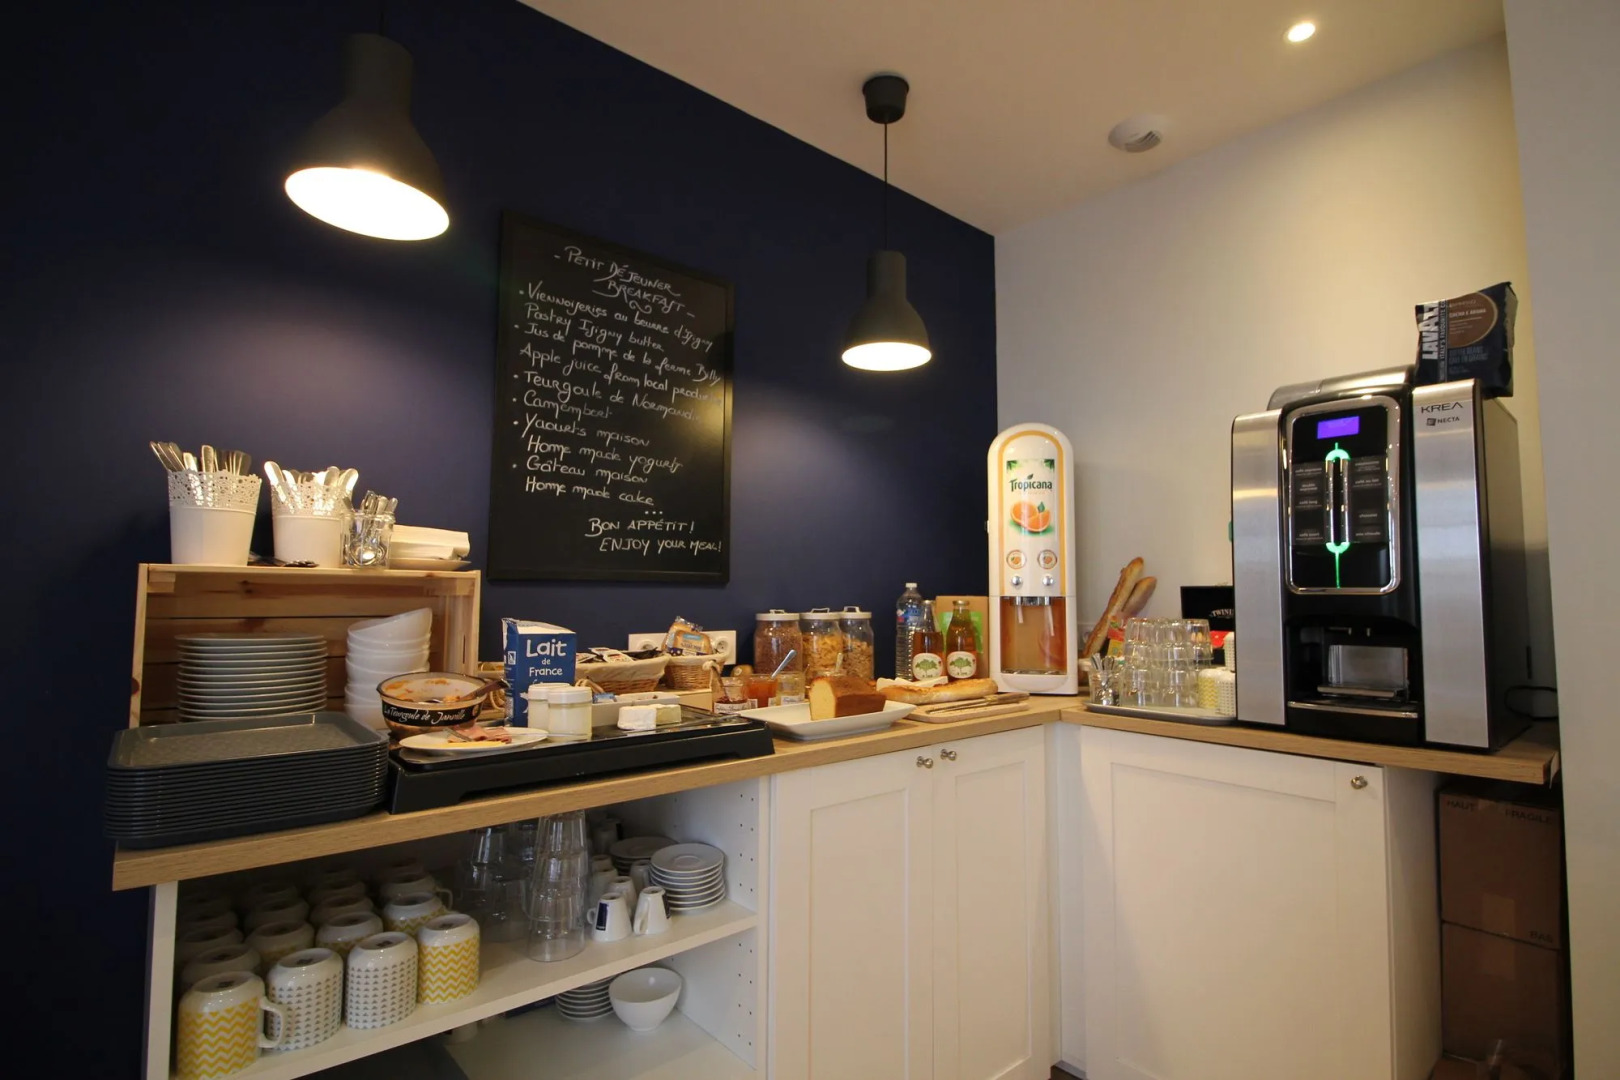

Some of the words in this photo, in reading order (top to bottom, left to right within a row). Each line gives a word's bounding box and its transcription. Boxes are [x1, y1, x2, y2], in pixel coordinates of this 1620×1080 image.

[592, 280, 685, 313] BREAKFAST
[525, 302, 571, 336] Pastry
[628, 332, 664, 352] butter
[614, 312, 628, 322] au
[524, 322, 549, 338] Jus
[553, 330, 565, 342] de
[572, 340, 618, 361] pomme
[623, 350, 635, 362] de
[643, 352, 652, 365] la
[655, 357, 691, 376] ferme
[520, 342, 560, 368] Apple
[562, 358, 602, 376] juice
[604, 362, 640, 387] from
[644, 373, 668, 391] local
[524, 370, 602, 403] Teurgoule
[610, 389, 624, 404] de
[524, 390, 612, 421] Camembert
[1438, 416, 1460, 424] NECTA
[522, 412, 587, 438] Yaourts
[596, 430, 650, 447] maison
[527, 434, 571, 461] Home
[579, 447, 621, 464] made
[526, 455, 586, 476] Gâteau
[596, 469, 648, 485] maison
[1009, 478, 1053, 492] Tropicana
[525, 476, 566, 496] Home
[572, 486, 610, 500] made
[618, 490, 654, 506] cake
[600, 538, 650, 556] ENJOY
[526, 639, 567, 658] Lait
[529, 667, 562, 677] France
[421, 710, 430, 720] de
